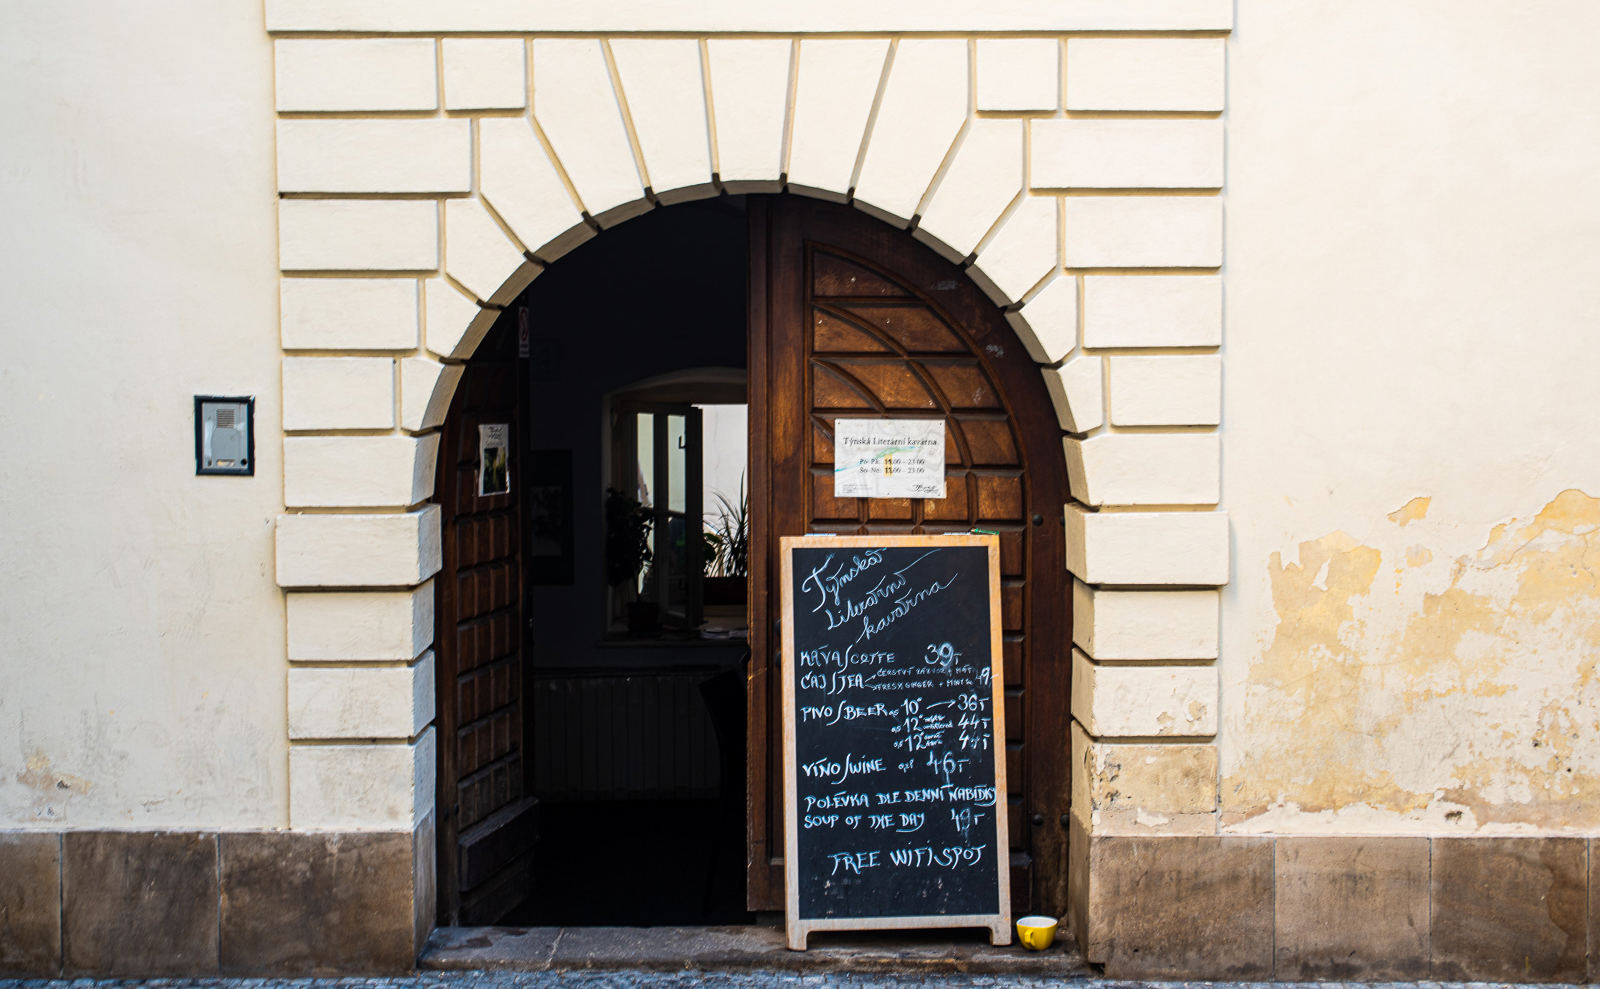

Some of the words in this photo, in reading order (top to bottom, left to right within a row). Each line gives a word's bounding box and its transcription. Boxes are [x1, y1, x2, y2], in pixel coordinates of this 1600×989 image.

[843, 436, 871, 446] Týnská
[873, 436, 906, 446] Literární
[907, 436, 938, 446] kavárna
[802, 548, 888, 613] Týnská
[856, 572, 959, 644] kavárna
[803, 791, 870, 812] POLÉVKA
[876, 791, 902, 805] DLE
[904, 784, 954, 803] DENNÍ
[948, 784, 998, 807] NABÍDKY
[804, 814, 839, 829] SOUP
[845, 815, 863, 829] OF
[867, 813, 895, 829] THE
[896, 812, 925, 833] DAY
[827, 851, 881, 876] FREE
[933, 843, 987, 870] SPOT
